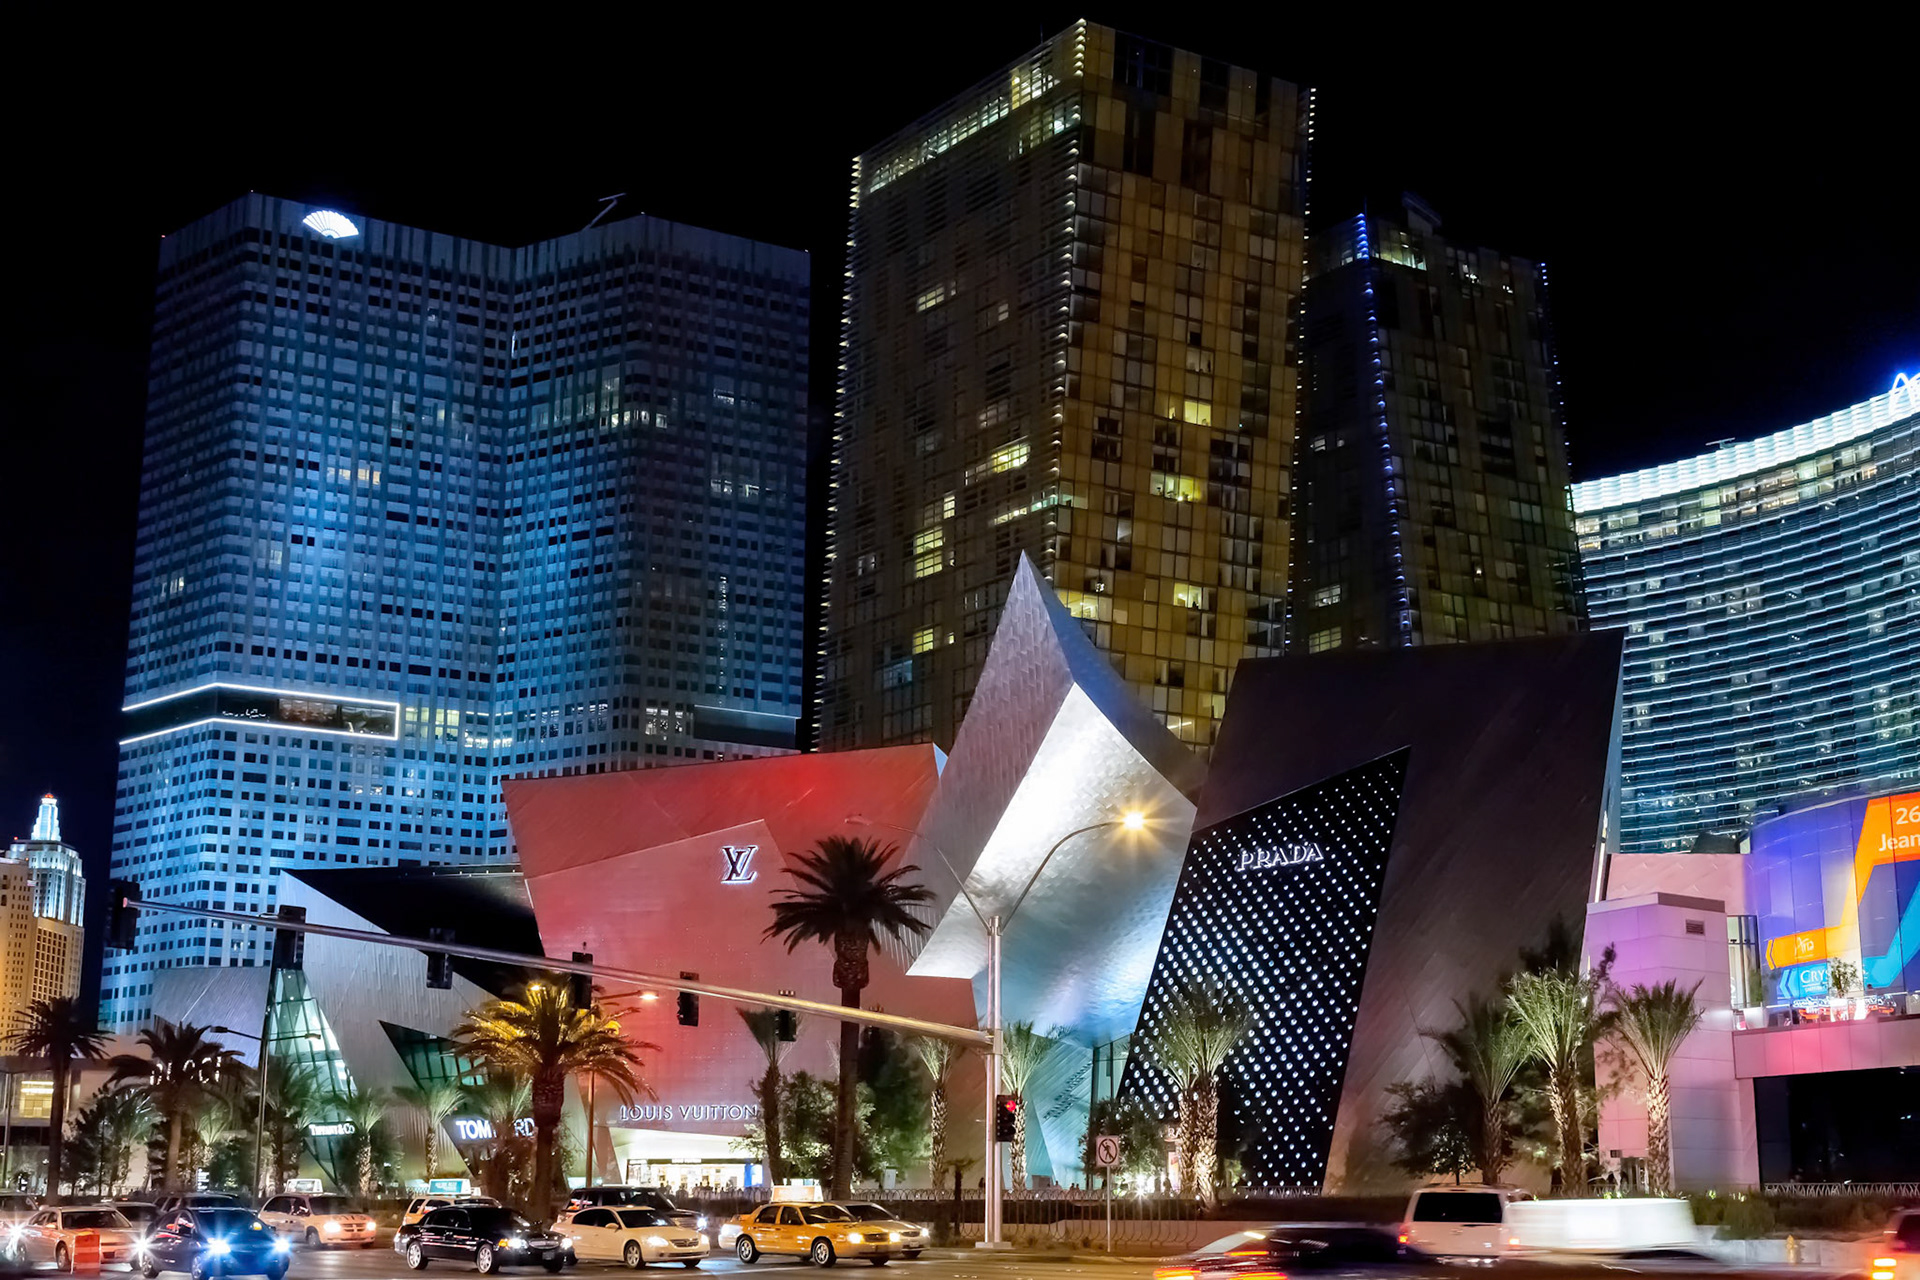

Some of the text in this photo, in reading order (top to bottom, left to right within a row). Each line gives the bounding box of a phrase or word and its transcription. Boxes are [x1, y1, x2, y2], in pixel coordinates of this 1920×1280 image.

[1235, 843, 1324, 871] PRADA
[619, 1104, 759, 1121] LOUIS VUITTON
[455, 1119, 492, 1139] TOM
